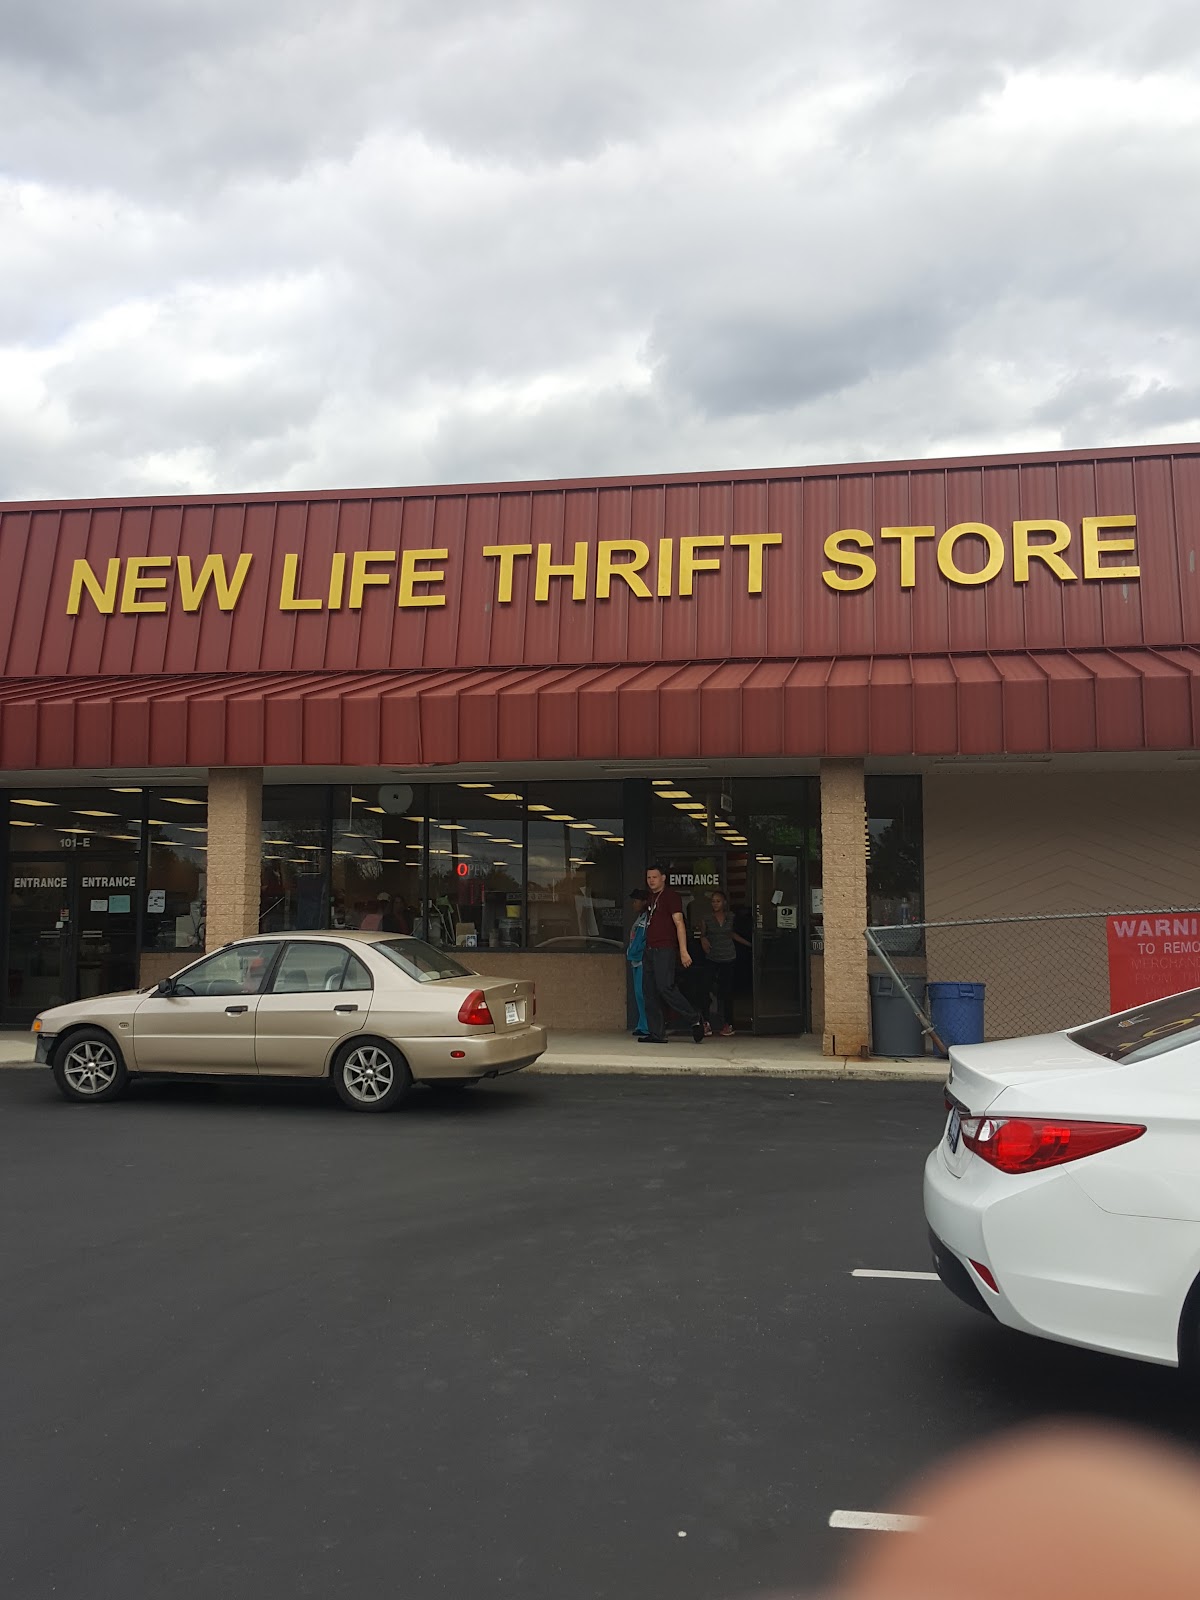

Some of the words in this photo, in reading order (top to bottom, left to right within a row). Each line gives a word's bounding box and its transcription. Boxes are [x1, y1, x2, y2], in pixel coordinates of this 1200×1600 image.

[66, 553, 252, 615] NEW
[279, 548, 448, 610] LIFE
[483, 533, 782, 602] THRIFT
[822, 515, 1140, 591] STORE
[60, 838, 90, 848] 101-E
[14, 877, 68, 888] ENTRANCE
[82, 876, 136, 888] ENTRANCE
[669, 873, 719, 886] ENTRANCE
[1138, 942, 1156, 955] TO
